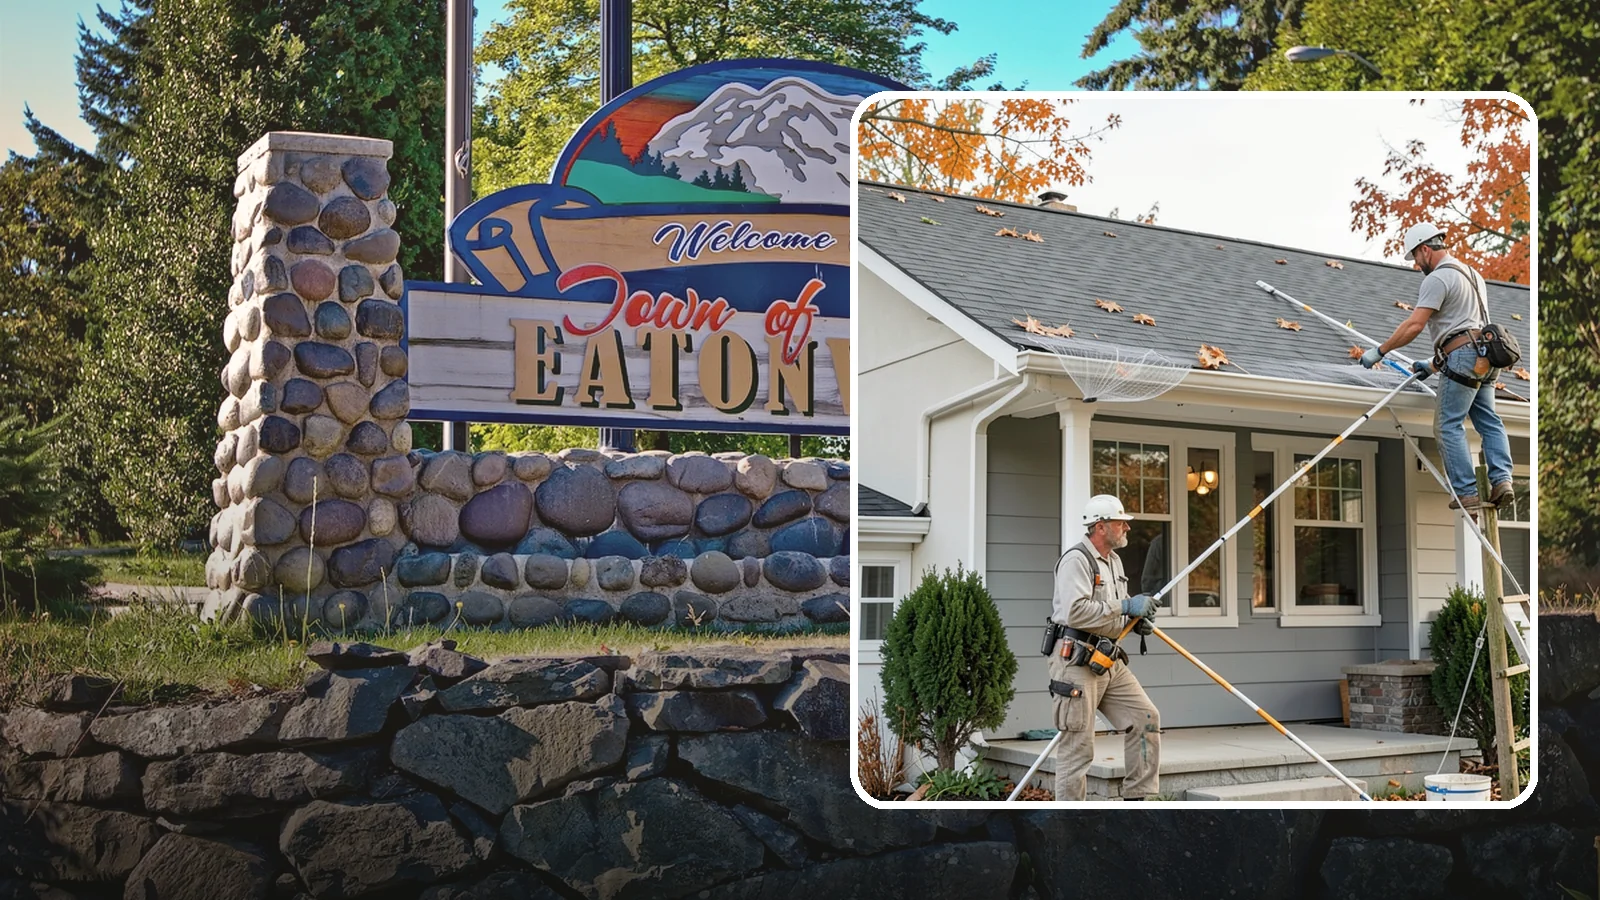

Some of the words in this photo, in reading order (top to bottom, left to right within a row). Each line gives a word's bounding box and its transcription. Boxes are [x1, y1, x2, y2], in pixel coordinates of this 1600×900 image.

[653, 221, 836, 263] Welcome
[557, 264, 736, 336] Town
[765, 279, 826, 365] of
